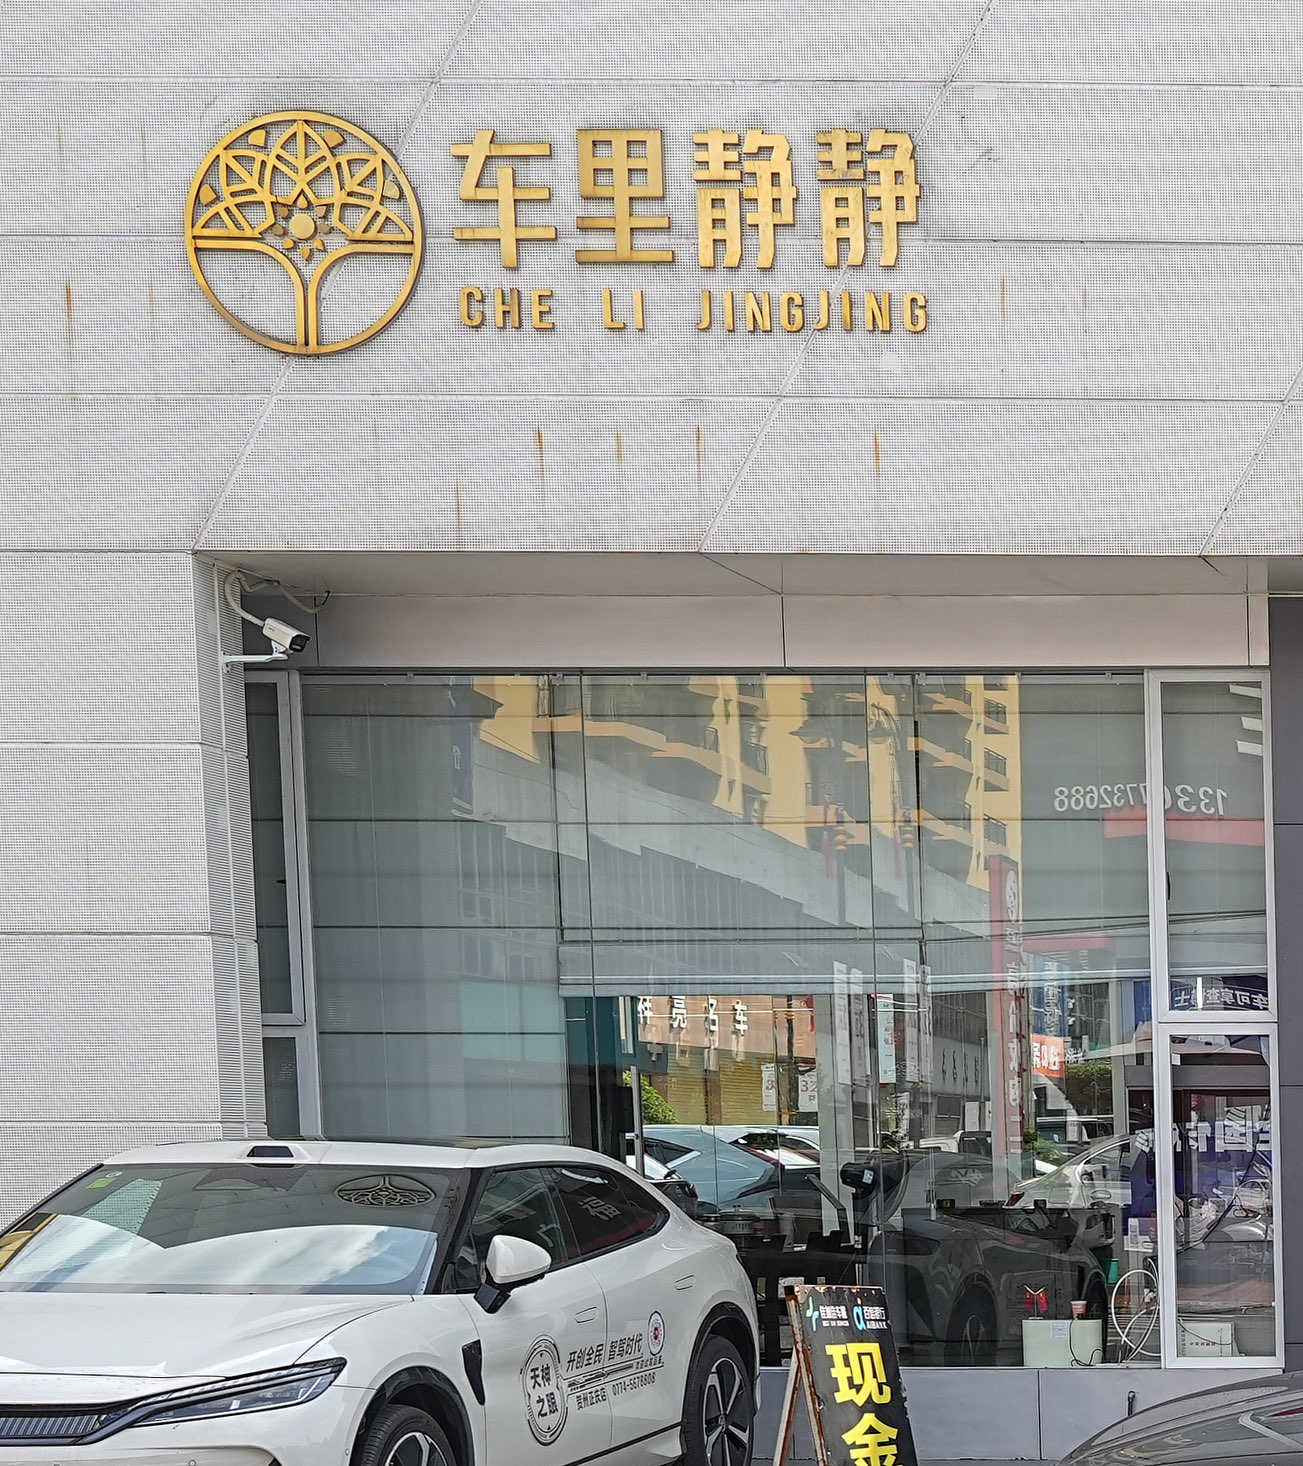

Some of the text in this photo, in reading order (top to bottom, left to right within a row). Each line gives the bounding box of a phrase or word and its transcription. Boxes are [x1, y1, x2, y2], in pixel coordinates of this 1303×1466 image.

[450, 128, 920, 269] 车里静静
[459, 285, 929, 333] CHE LI JINGJING
[566, 1343, 604, 1373] 开创全民
[530, 1363, 552, 1390] 天神
[536, 1391, 559, 1418] 之眼
